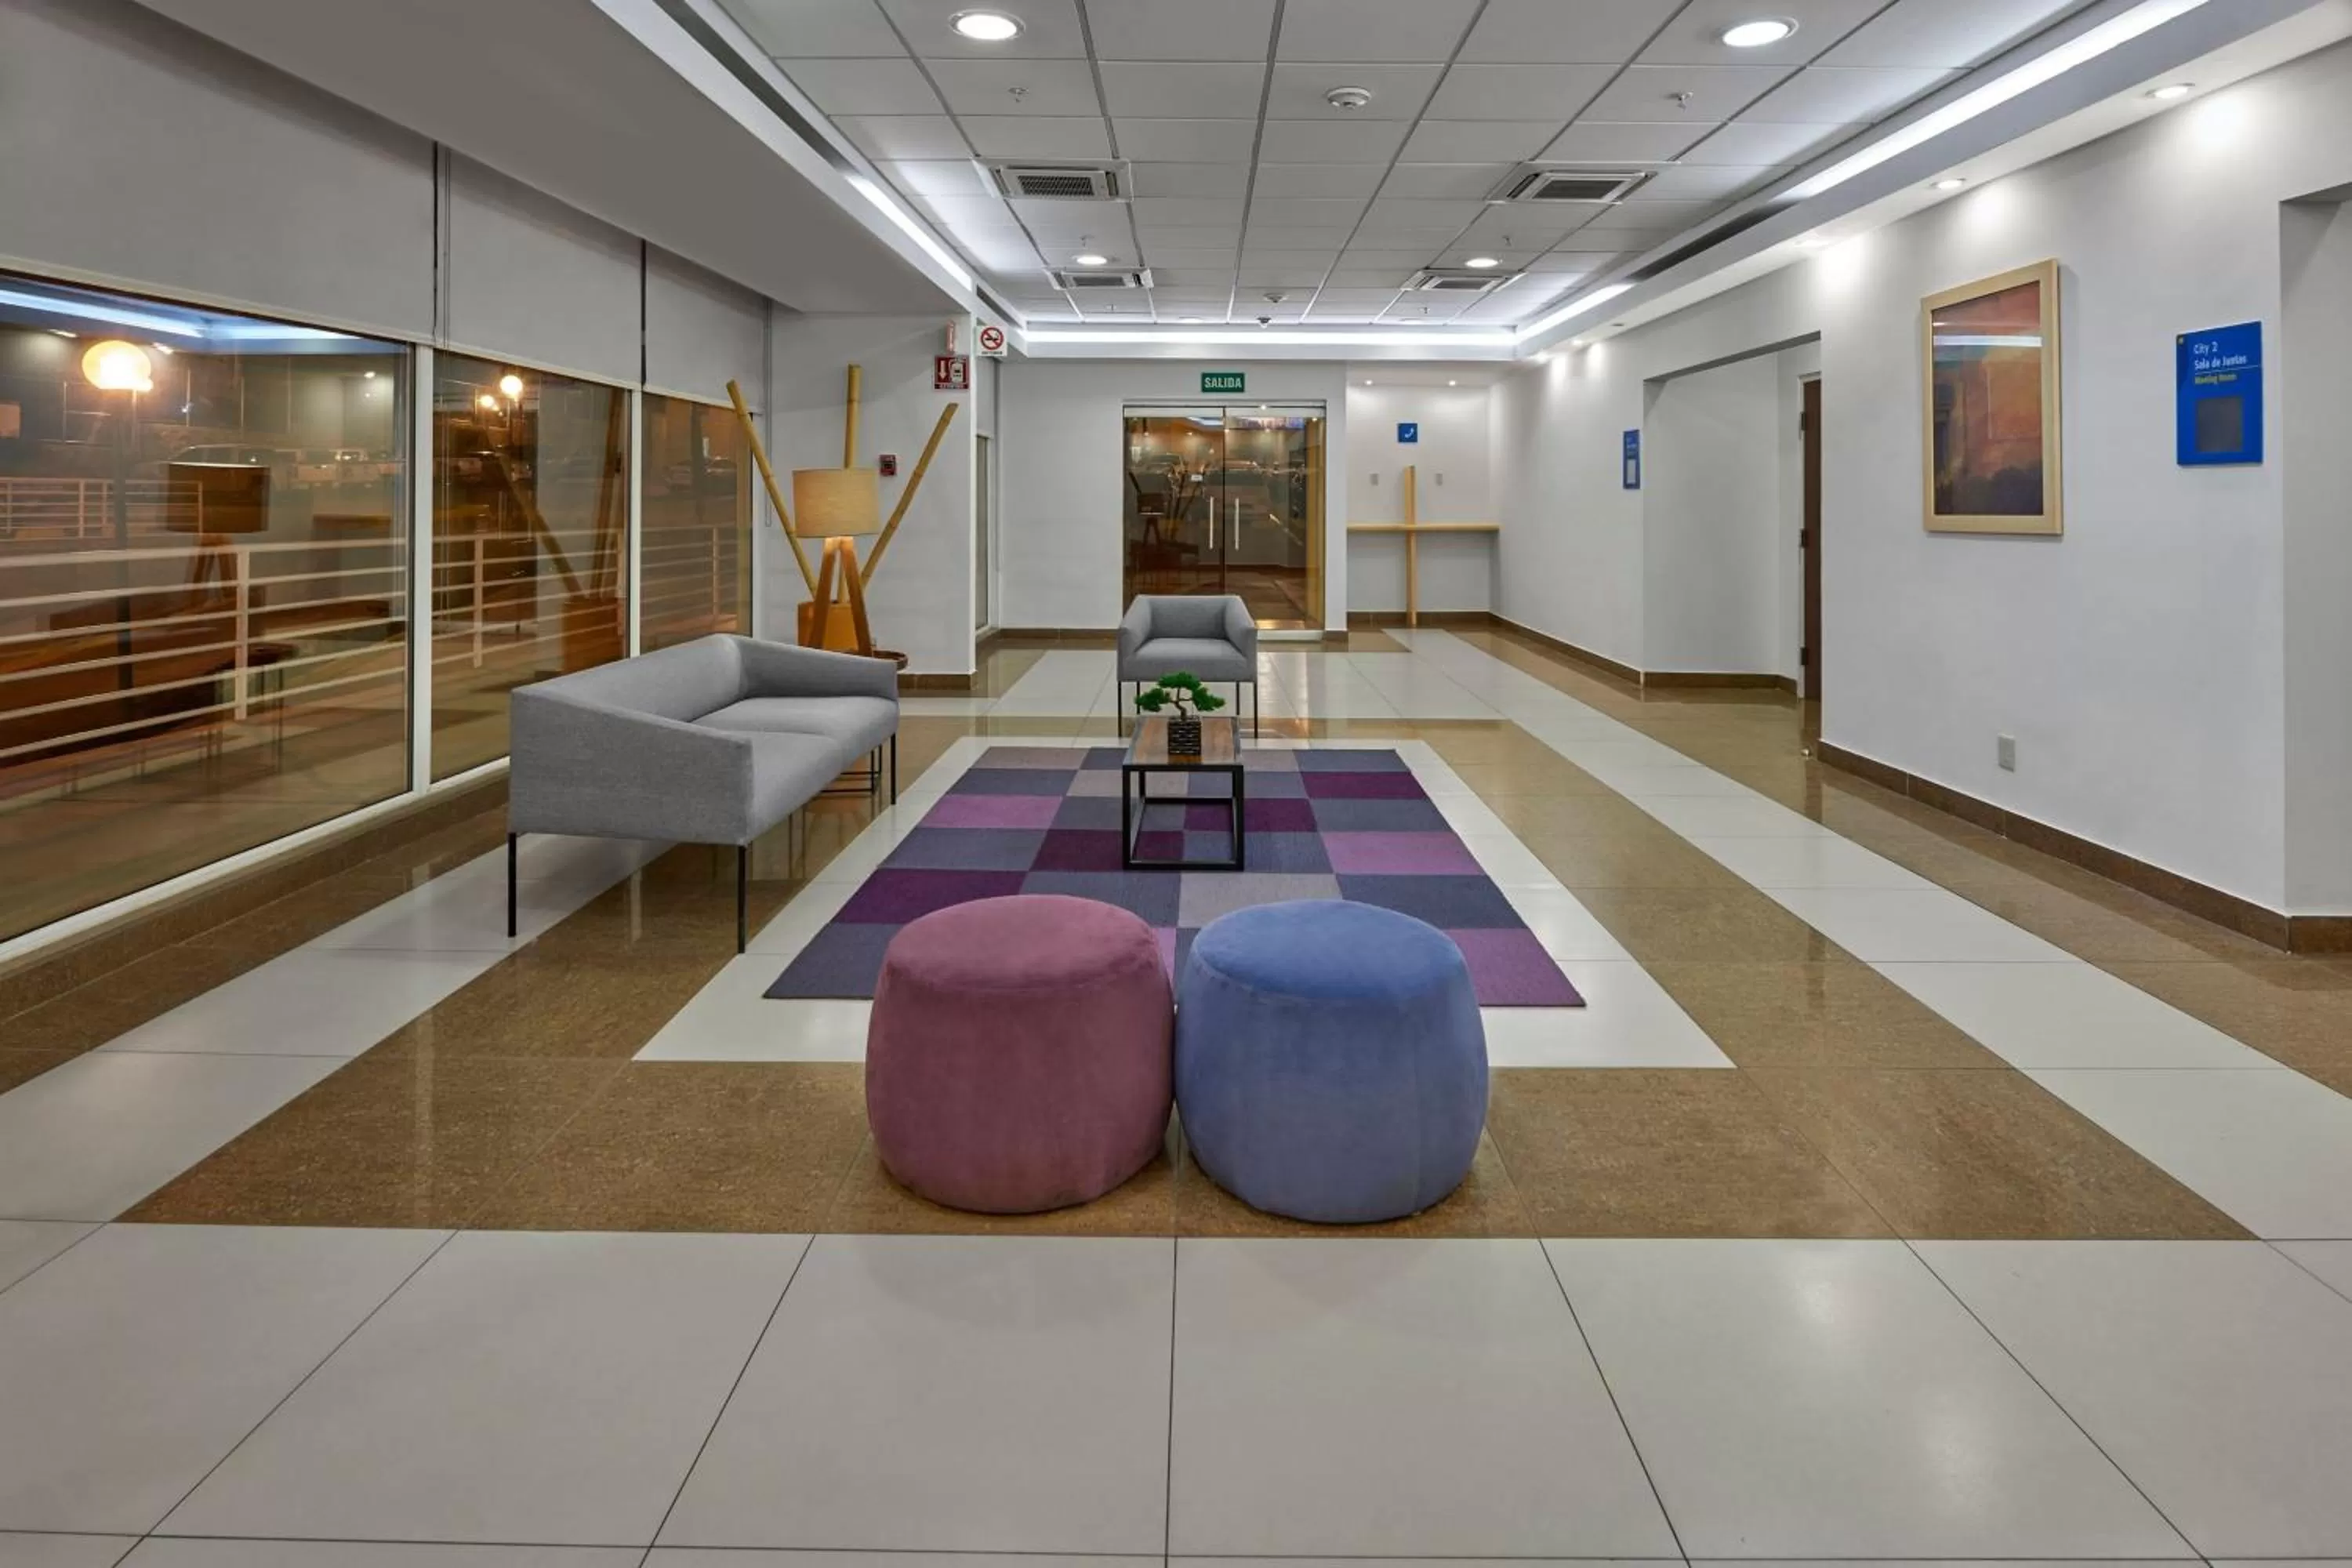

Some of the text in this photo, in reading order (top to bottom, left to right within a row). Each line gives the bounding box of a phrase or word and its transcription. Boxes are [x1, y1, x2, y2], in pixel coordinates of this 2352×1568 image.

[2194, 341, 2218, 356] City 2
[1204, 377, 1243, 388] SALIDA
